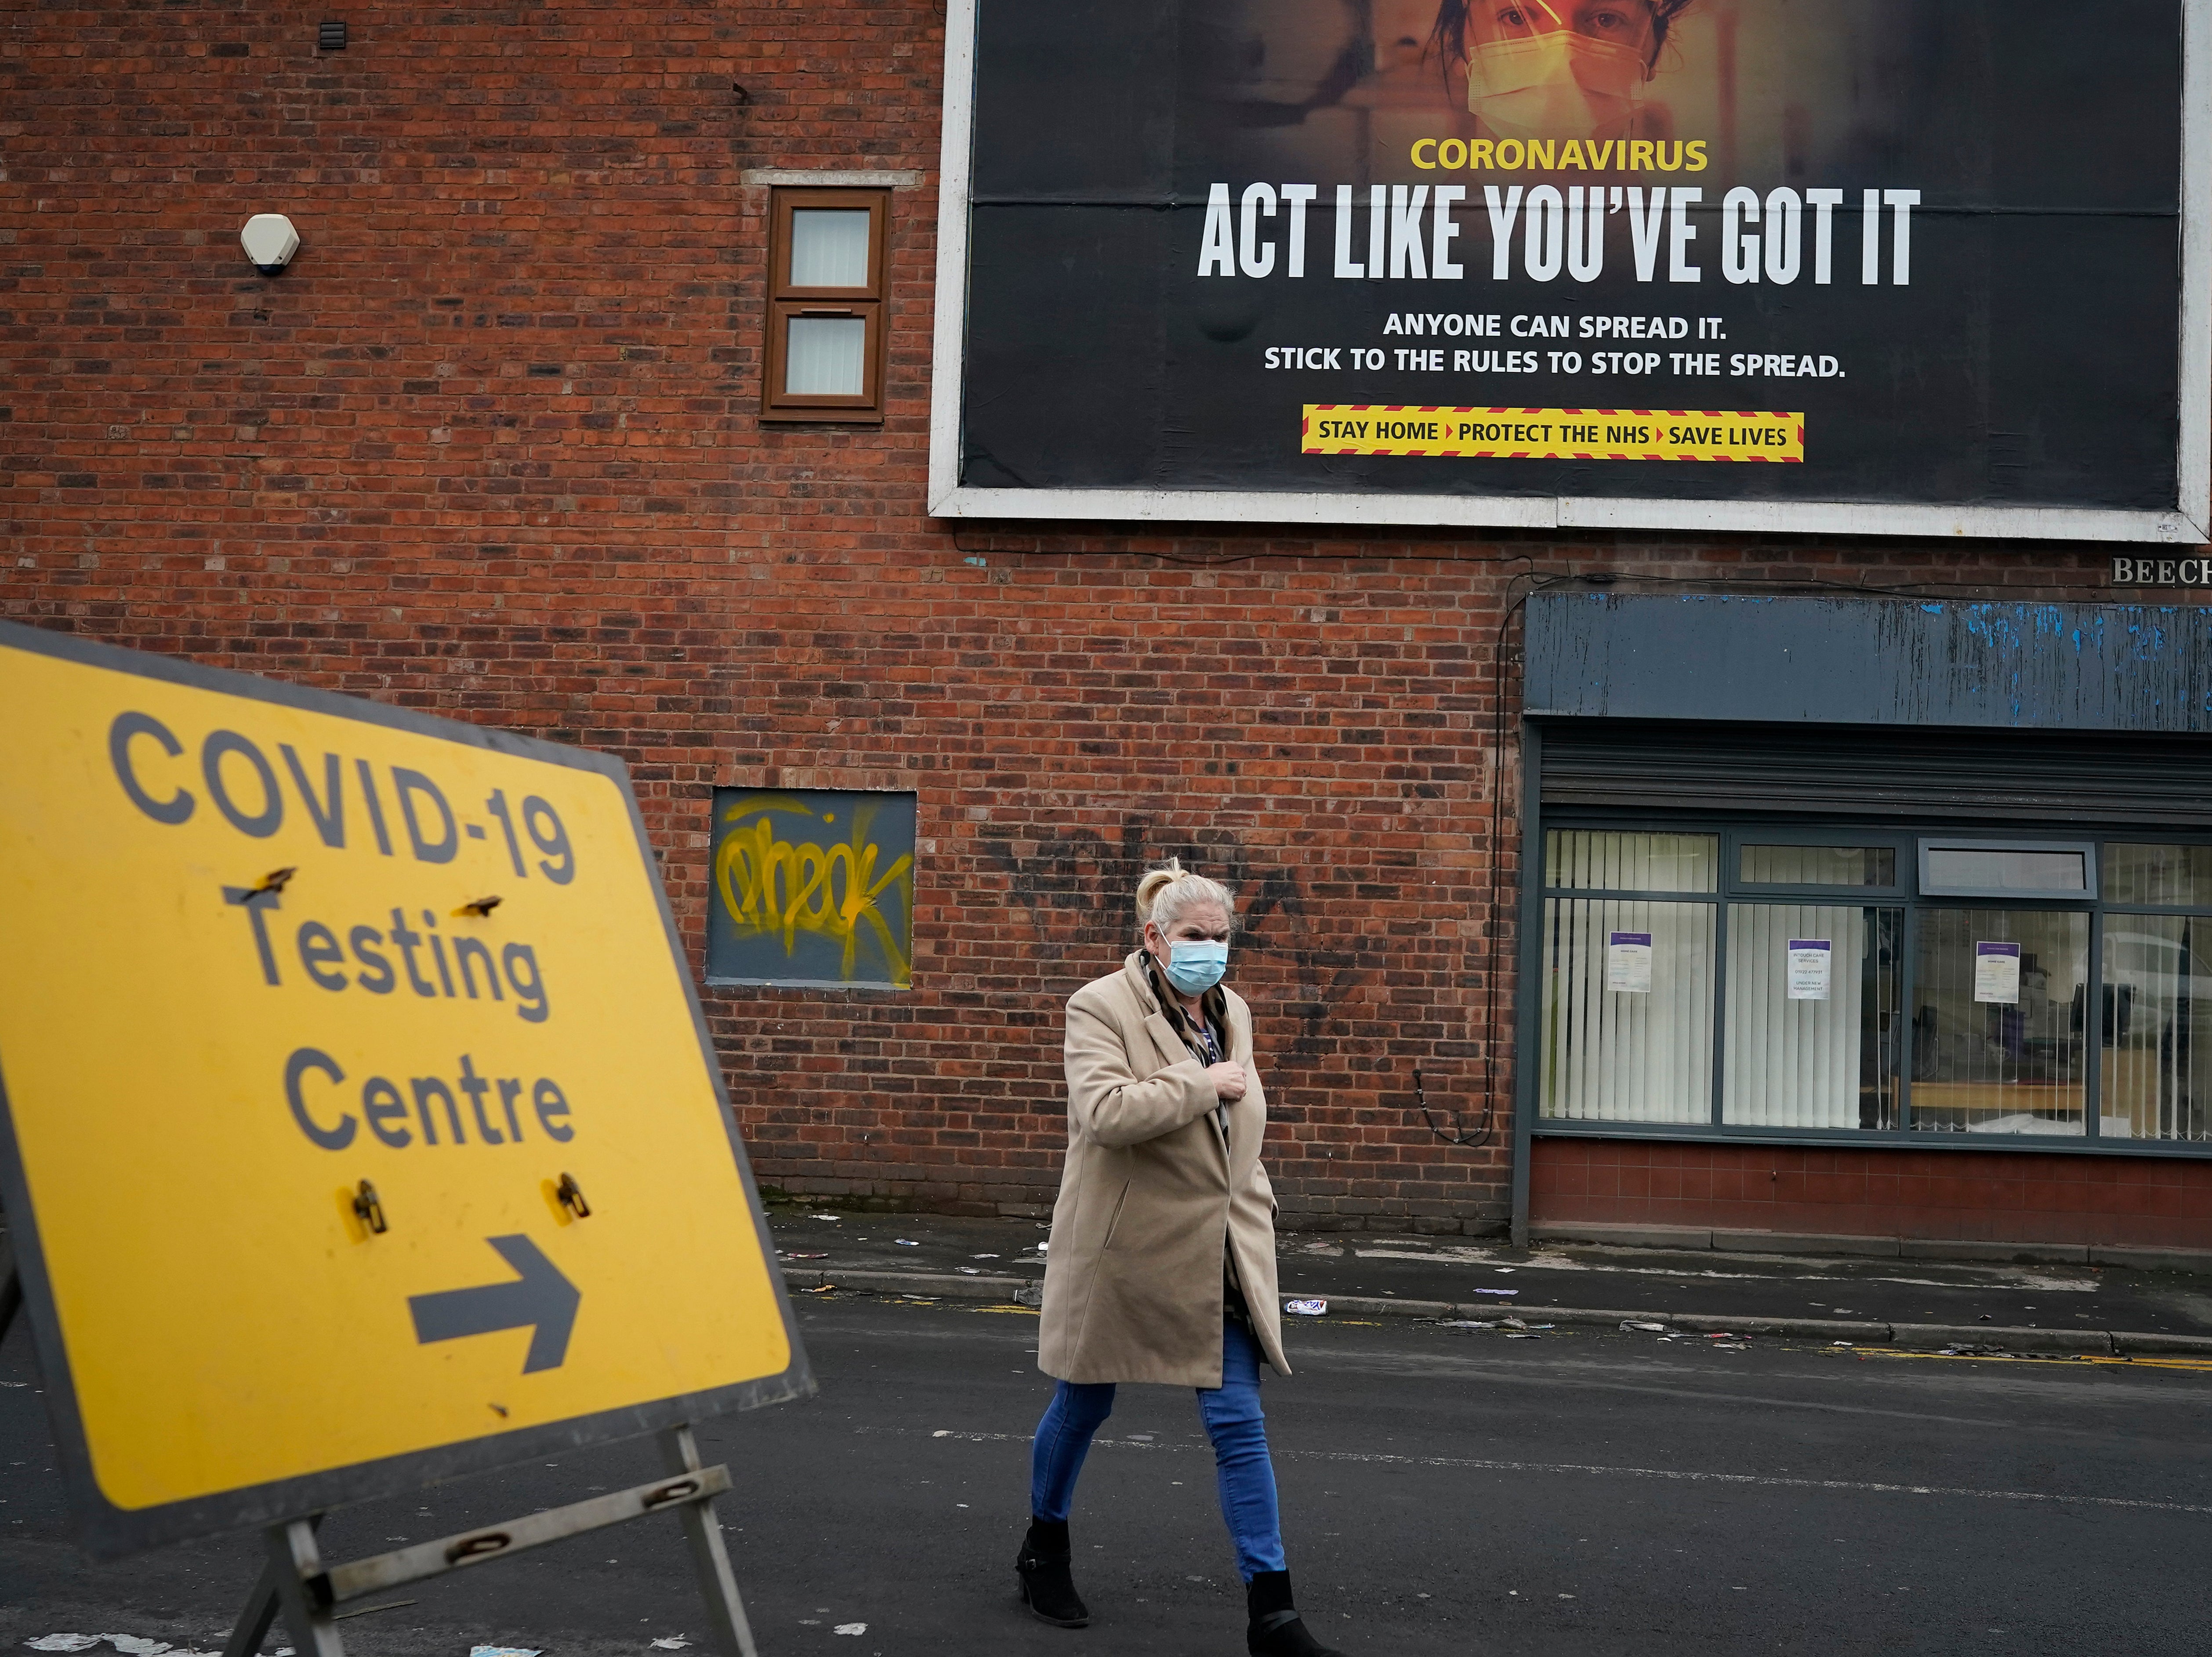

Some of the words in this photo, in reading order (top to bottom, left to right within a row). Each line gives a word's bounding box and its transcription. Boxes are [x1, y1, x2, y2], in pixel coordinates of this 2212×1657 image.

[1411, 138, 1707, 171] CORONAVIRUS
[1197, 182, 1316, 278] ACT
[1334, 185, 1465, 279] LIKE
[1722, 187, 1842, 285] GOT
[1863, 189, 1920, 285] IT
[1383, 314, 1500, 336] ANYONE
[1511, 315, 1569, 337] CAN
[1580, 316, 1688, 338] SPREAD
[1699, 318, 1726, 340] IT.
[1265, 347, 1341, 369] STICK
[1350, 349, 1385, 370] TO
[1394, 349, 1443, 371] THE
[1454, 350, 1538, 373] RULES
[1548, 352, 1581, 373] TO
[1592, 352, 1661, 374] STOP
[1669, 353, 1720, 375] THE
[1730, 354, 1845, 377] SPREAD.
[1320, 421, 1369, 438] STAY
[1377, 422, 1438, 439] HOME
[1460, 423, 1552, 441] PROTECT
[1559, 426, 1598, 442] THE
[1607, 426, 1649, 443] NHS
[1670, 427, 1722, 444] SAVE
[1730, 428, 1786, 445] LIVES
[109, 711, 573, 884] COVID-19
[221, 886, 548, 1022] Testing
[285, 1048, 573, 1150] Centre
